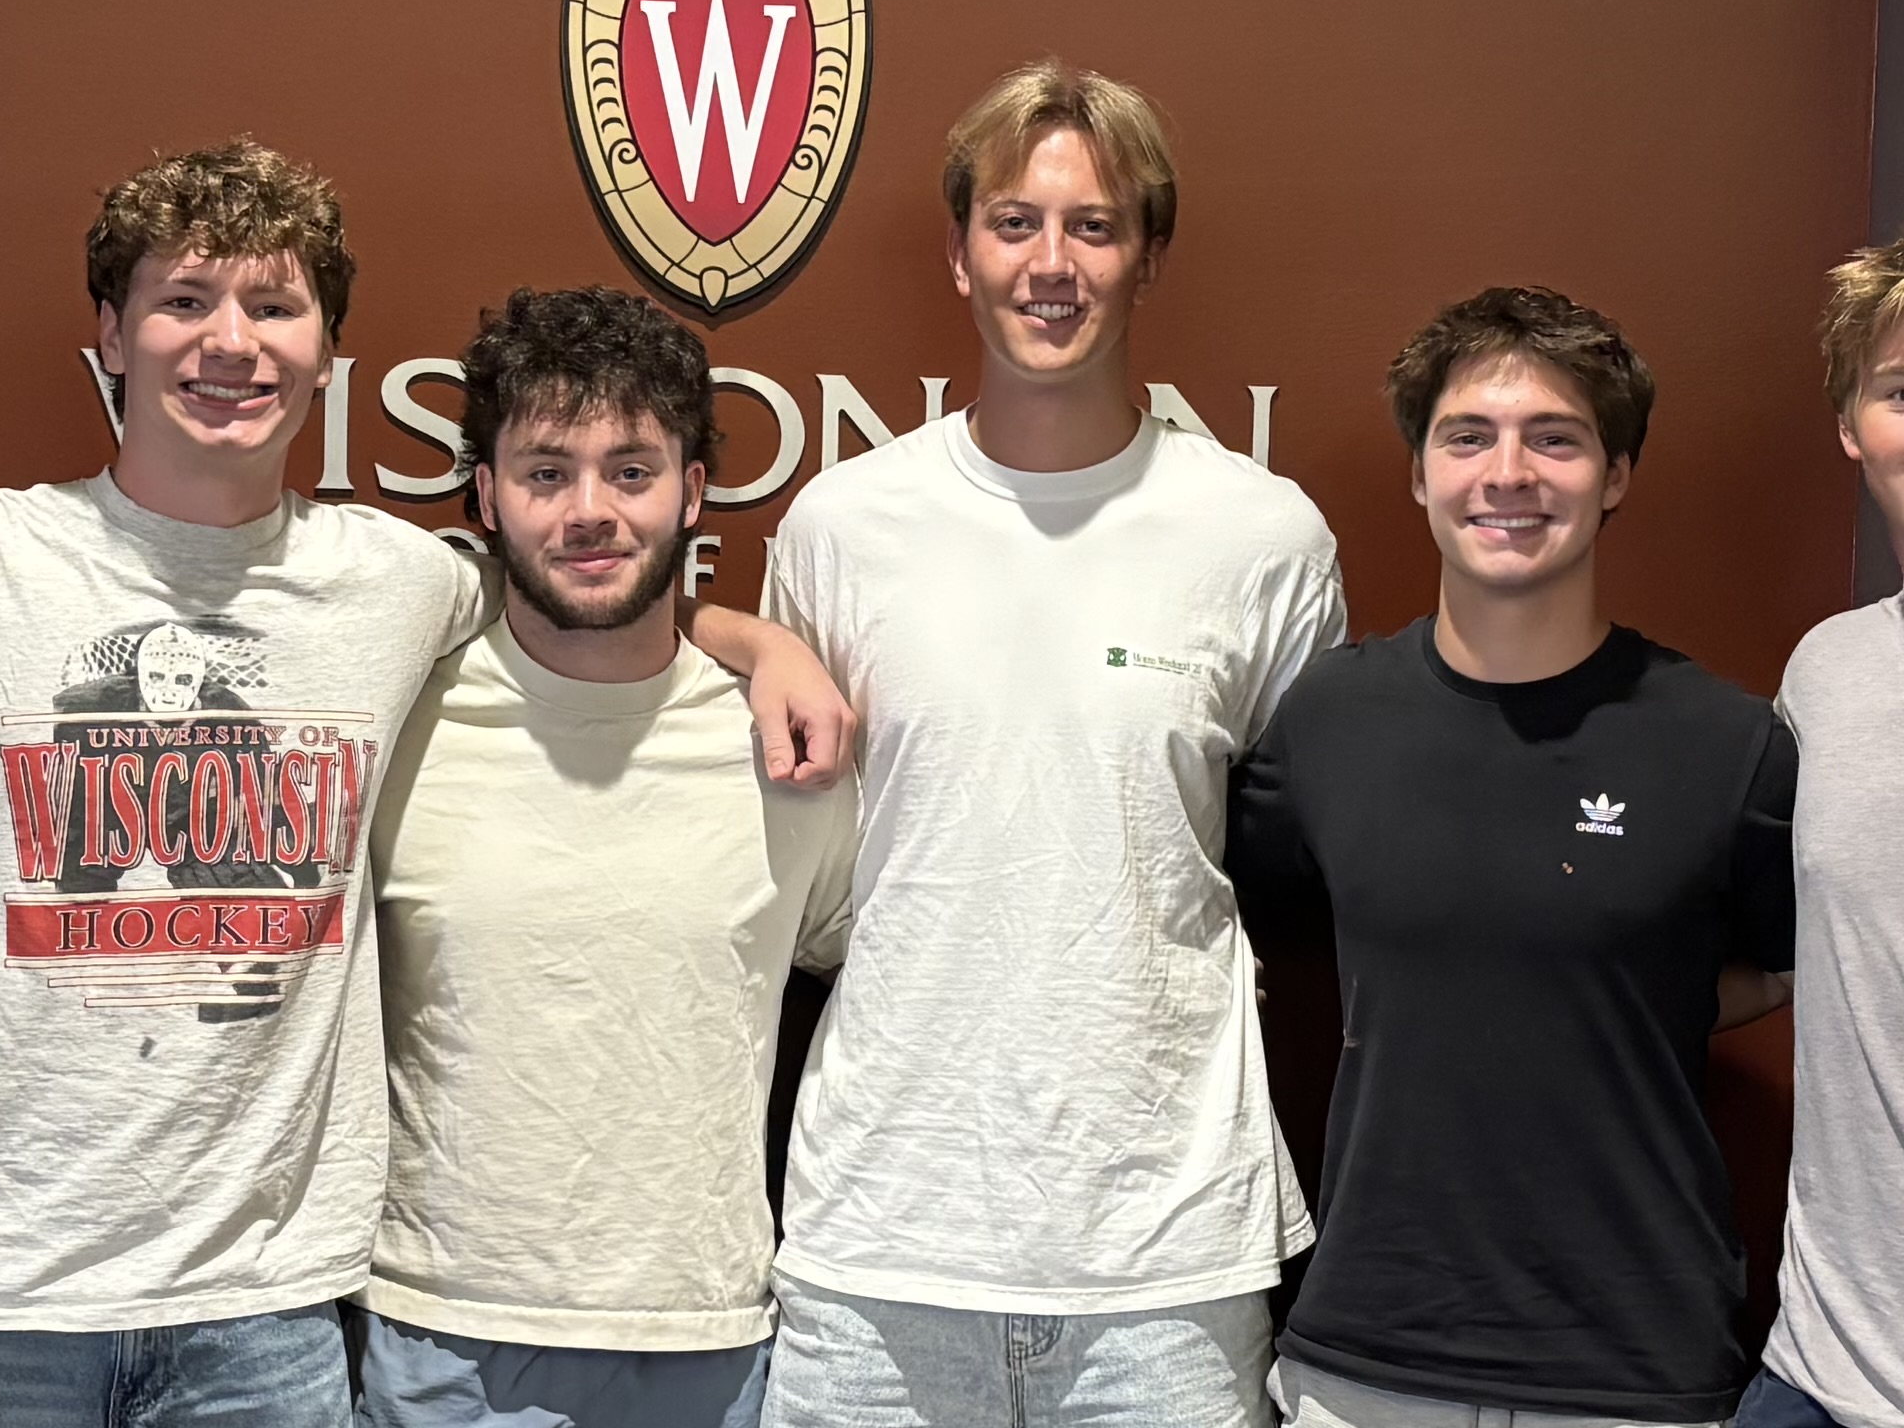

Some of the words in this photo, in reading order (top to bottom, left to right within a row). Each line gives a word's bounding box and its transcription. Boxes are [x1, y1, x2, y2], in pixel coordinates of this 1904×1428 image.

[87, 725, 287, 749] UNIVERSITY
[298, 725, 340, 748] OF
[0, 738, 379, 882] WISCONSIN
[1575, 821, 1625, 837] adidas
[56, 903, 326, 953] HOCKEY
